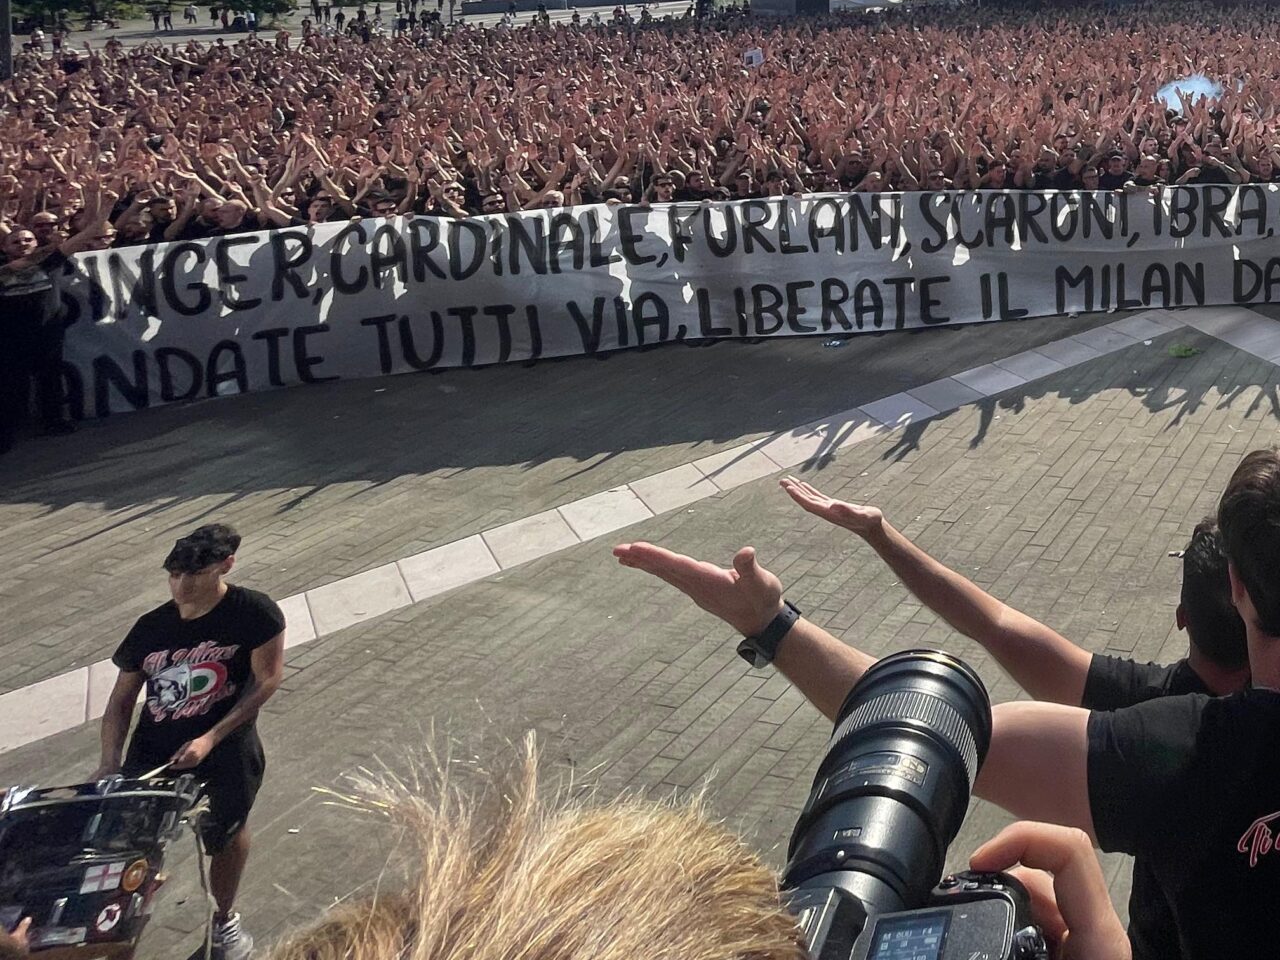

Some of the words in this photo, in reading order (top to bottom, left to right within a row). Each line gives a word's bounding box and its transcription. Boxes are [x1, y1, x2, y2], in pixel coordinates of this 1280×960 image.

[360, 304, 543, 374] TUTTI
[696, 274, 951, 338] LIBERATE
[980, 271, 1029, 321] IL
[1055, 260, 1205, 314] MILAN
